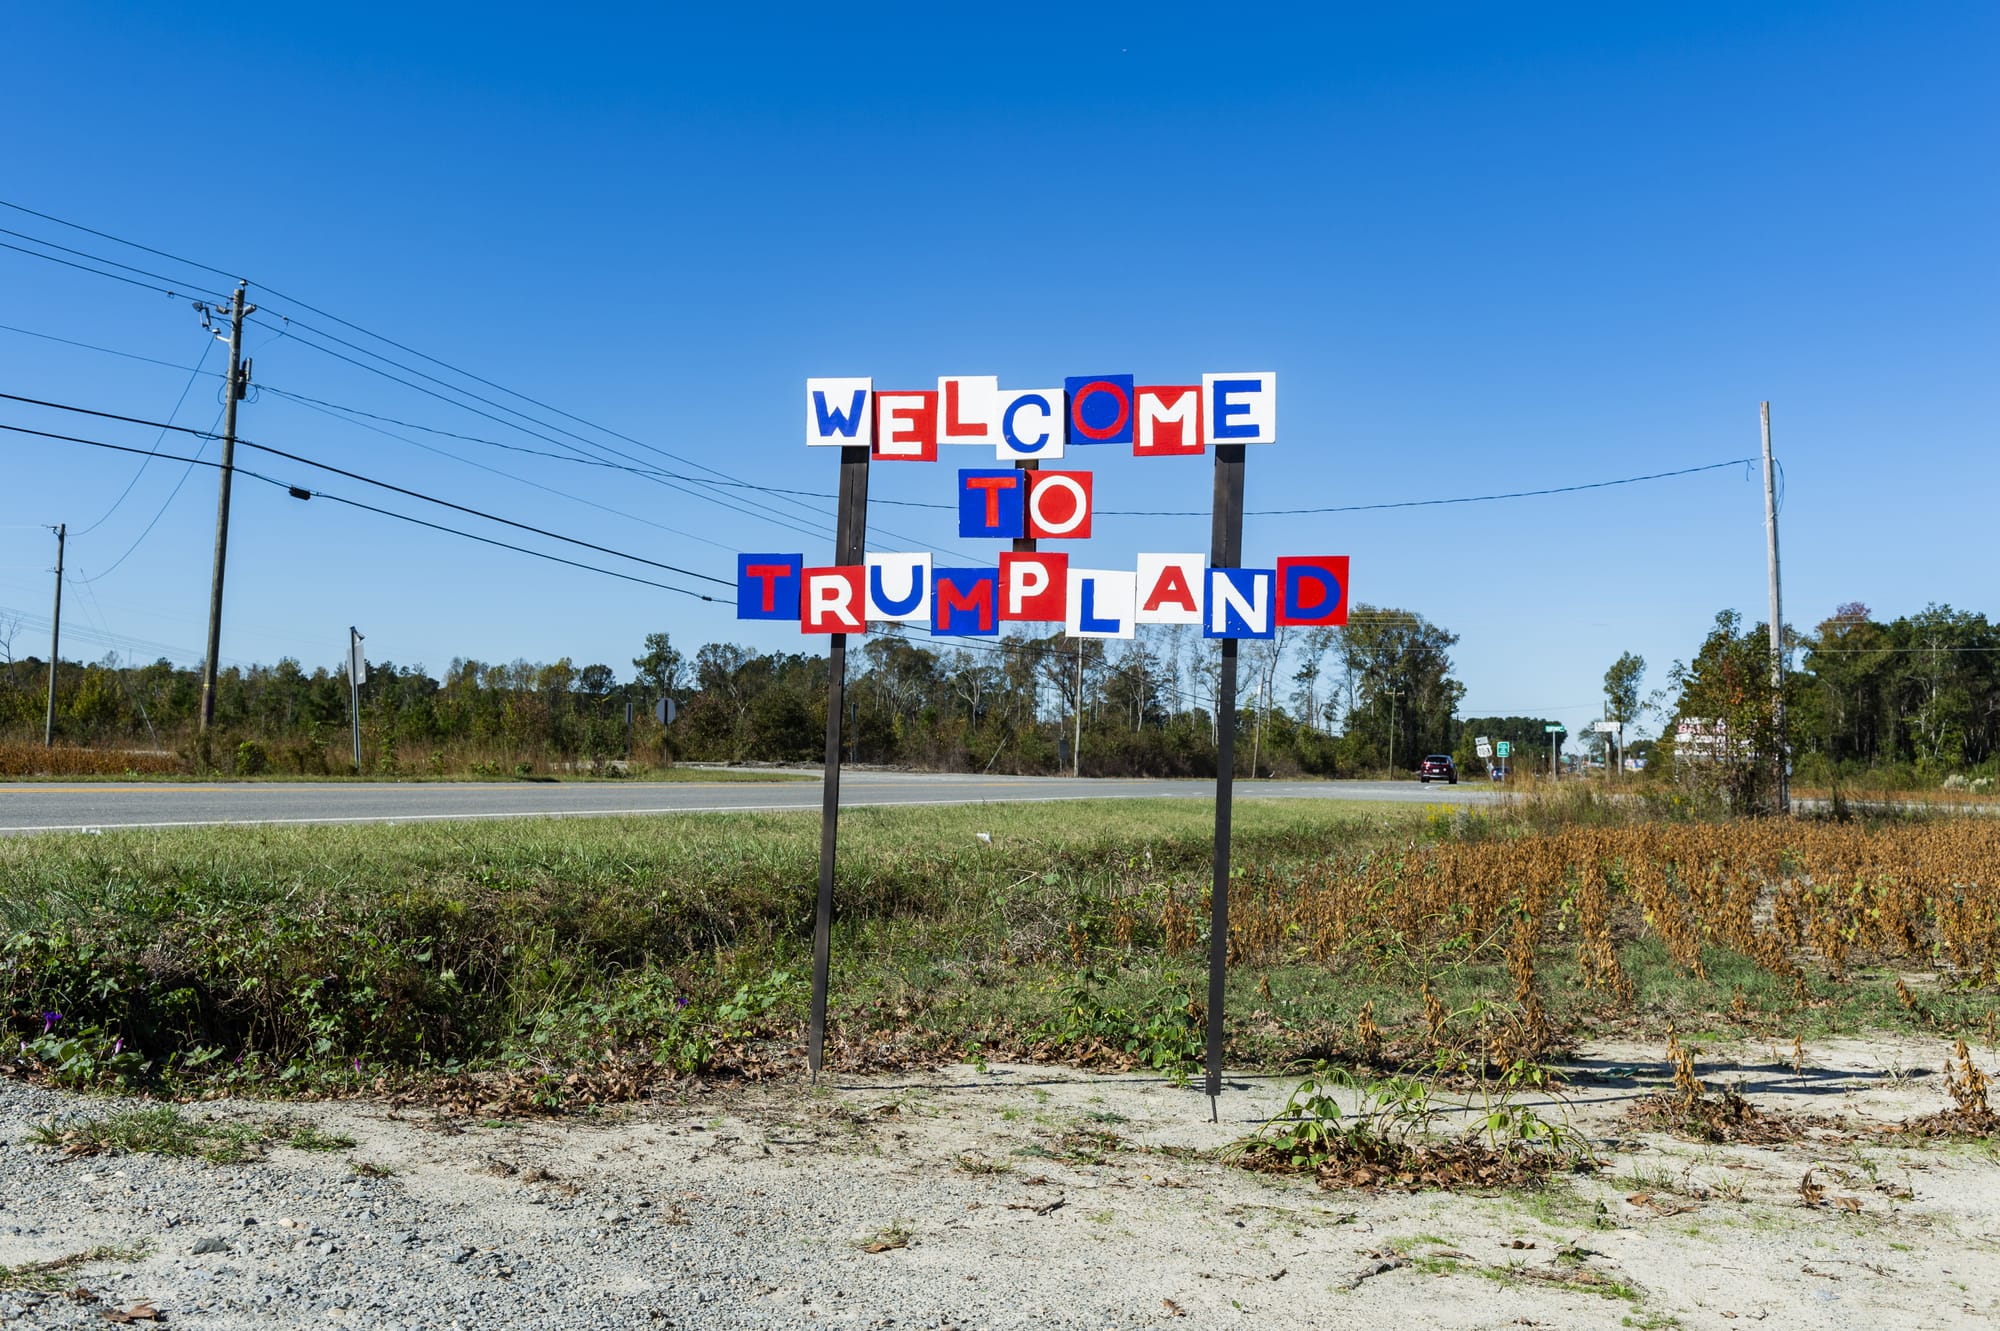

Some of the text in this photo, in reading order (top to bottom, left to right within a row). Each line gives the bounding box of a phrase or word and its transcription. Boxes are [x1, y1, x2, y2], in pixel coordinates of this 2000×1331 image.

[812, 379, 1262, 455] WELCOME
[966, 476, 1086, 534] TO
[746, 561, 1341, 634] TRUMPLAND
